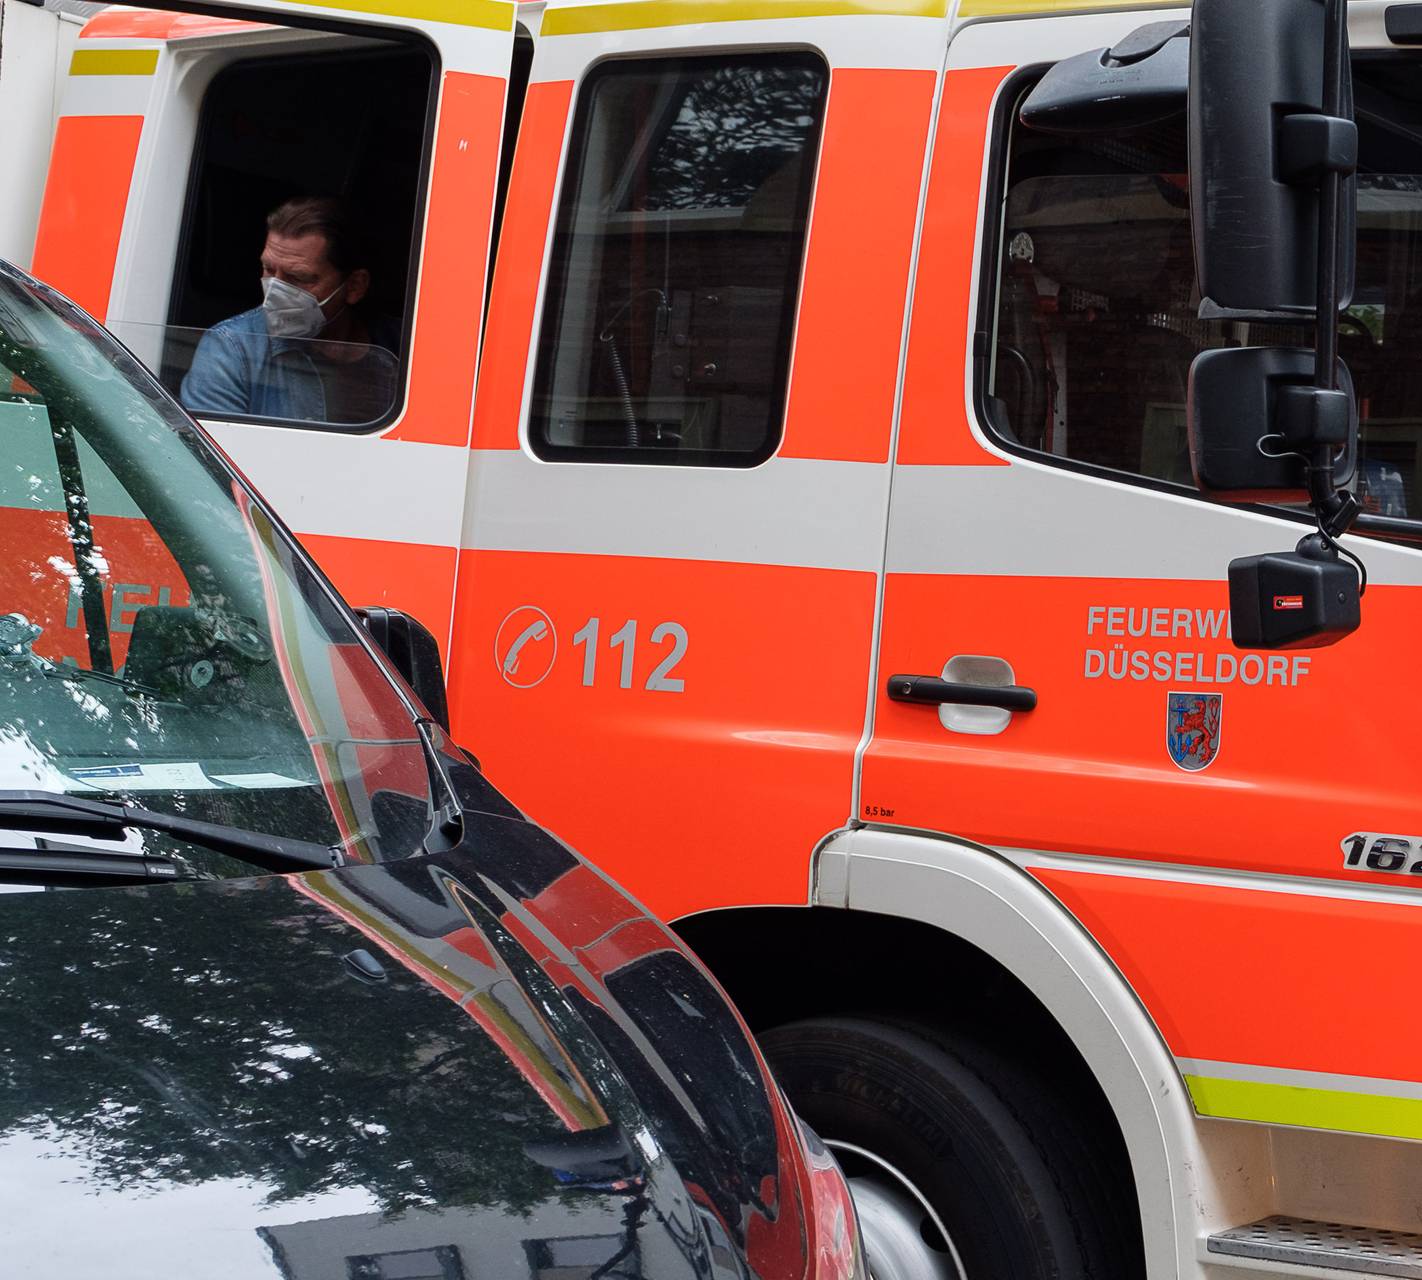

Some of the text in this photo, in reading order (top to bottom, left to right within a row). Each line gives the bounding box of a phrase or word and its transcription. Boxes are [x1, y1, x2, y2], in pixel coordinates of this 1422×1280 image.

[1087, 606, 1232, 639] FEUERW
[573, 617, 689, 693] 112
[1084, 643, 1312, 687] DÜSSELDORF
[864, 806, 895, 817] 8,5 bar
